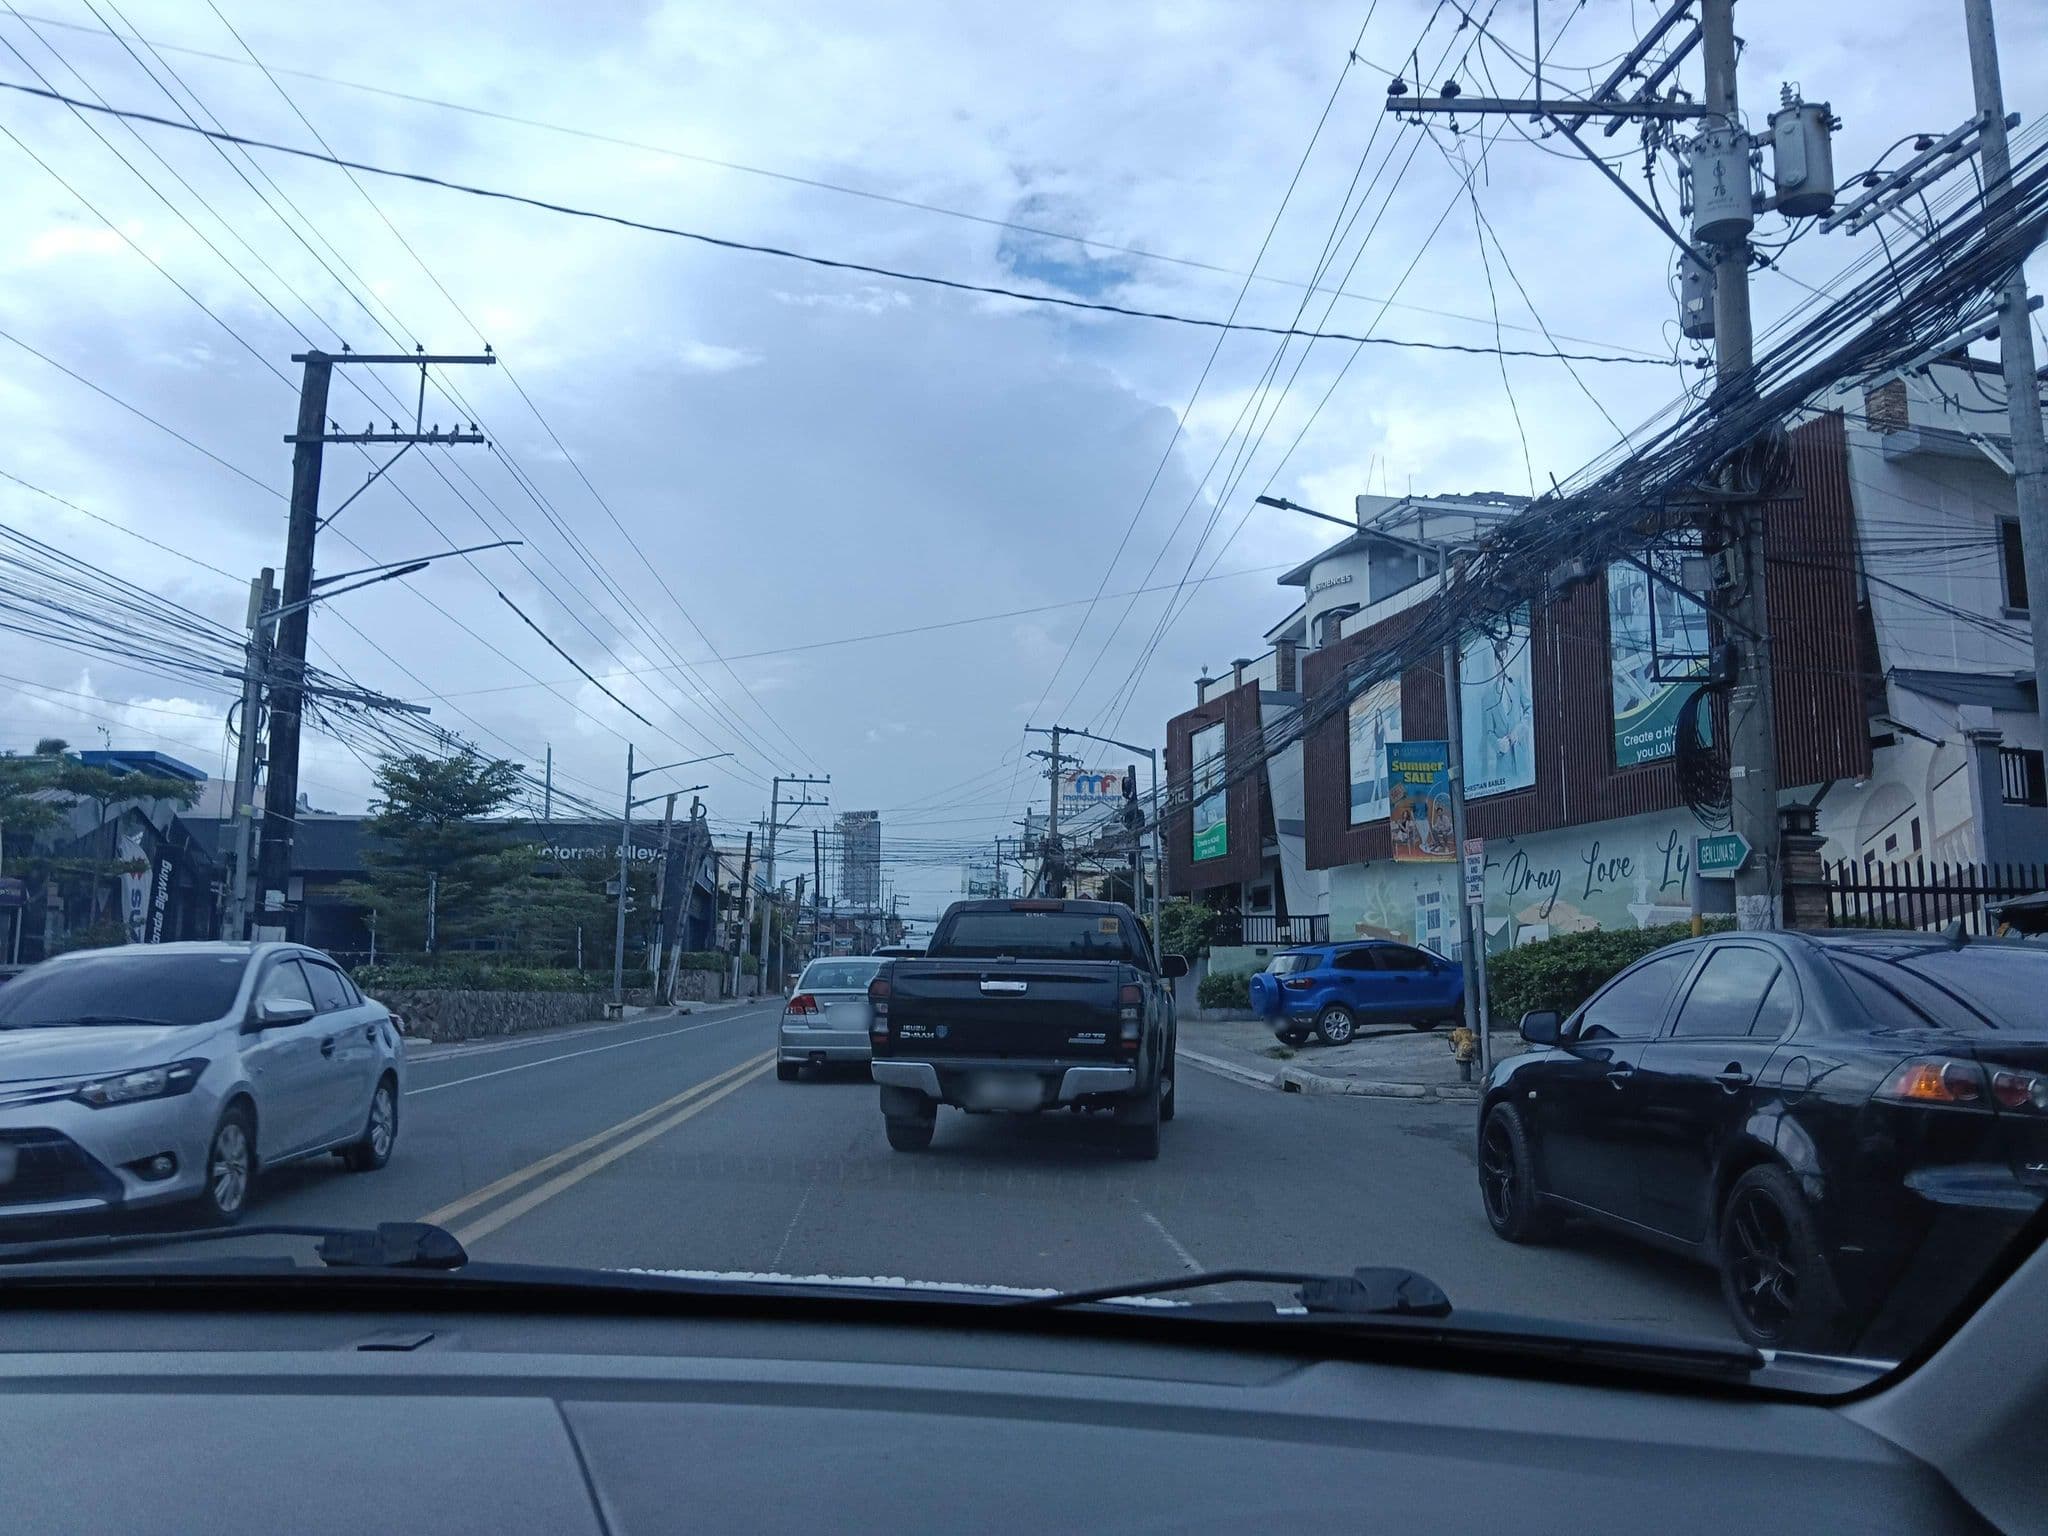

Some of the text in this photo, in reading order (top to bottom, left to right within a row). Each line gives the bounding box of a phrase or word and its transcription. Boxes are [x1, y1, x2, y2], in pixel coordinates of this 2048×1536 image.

[1623, 732, 1654, 747] Create
[1655, 729, 1662, 739] a
[1636, 745, 1654, 762] you
[1392, 760, 1445, 773] Summer
[1403, 772, 1435, 784] SALE
[1503, 848, 1561, 919] Pray
[1580, 841, 1634, 900] Love
[150, 859, 172, 944] onda BigWing
